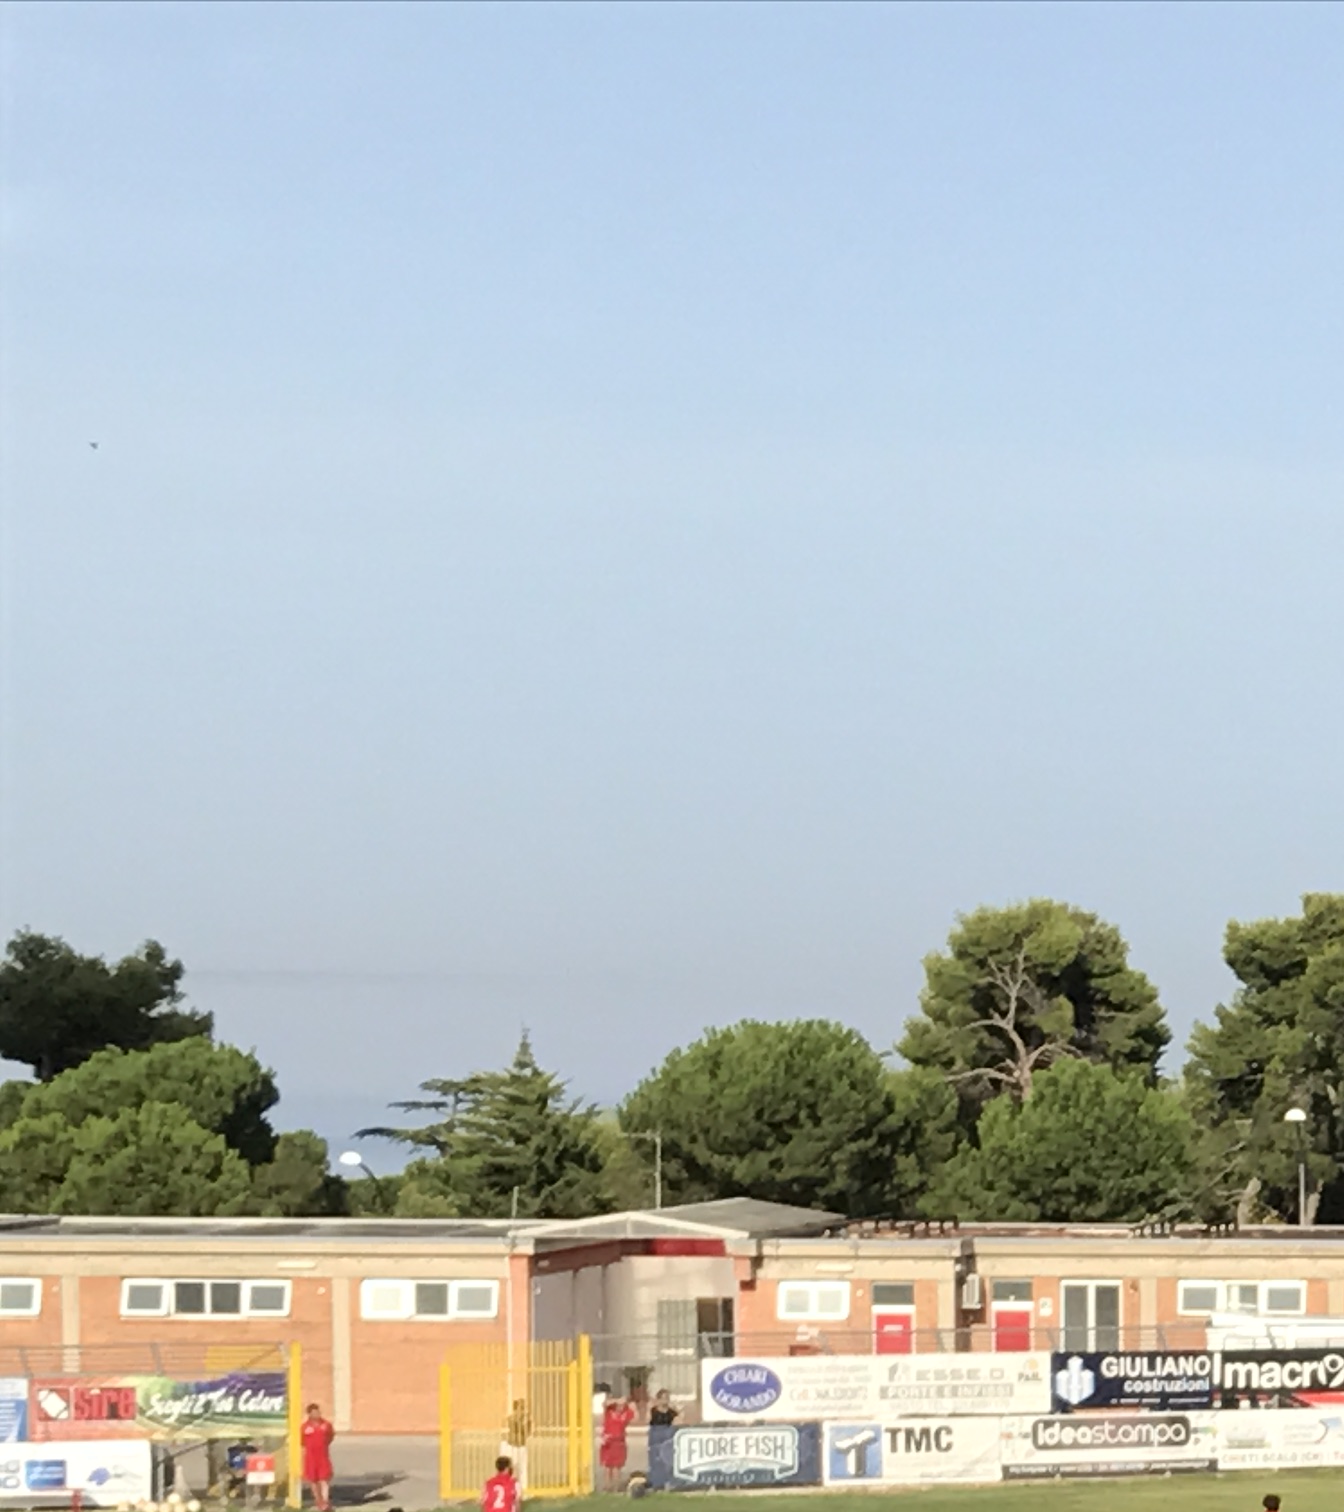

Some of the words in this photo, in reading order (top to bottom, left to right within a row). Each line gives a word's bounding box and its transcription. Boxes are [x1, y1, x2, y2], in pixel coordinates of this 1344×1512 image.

[1100, 1354, 1211, 1379] GIULIANO
[1122, 1377, 1211, 1399] costruzioni
[884, 1425, 954, 1453] TMC
[1036, 1420, 1187, 1448] ideastampa
[688, 1436, 739, 1463] FIORE
[745, 1436, 785, 1460] FISH
[492, 1484, 506, 1509] 2
